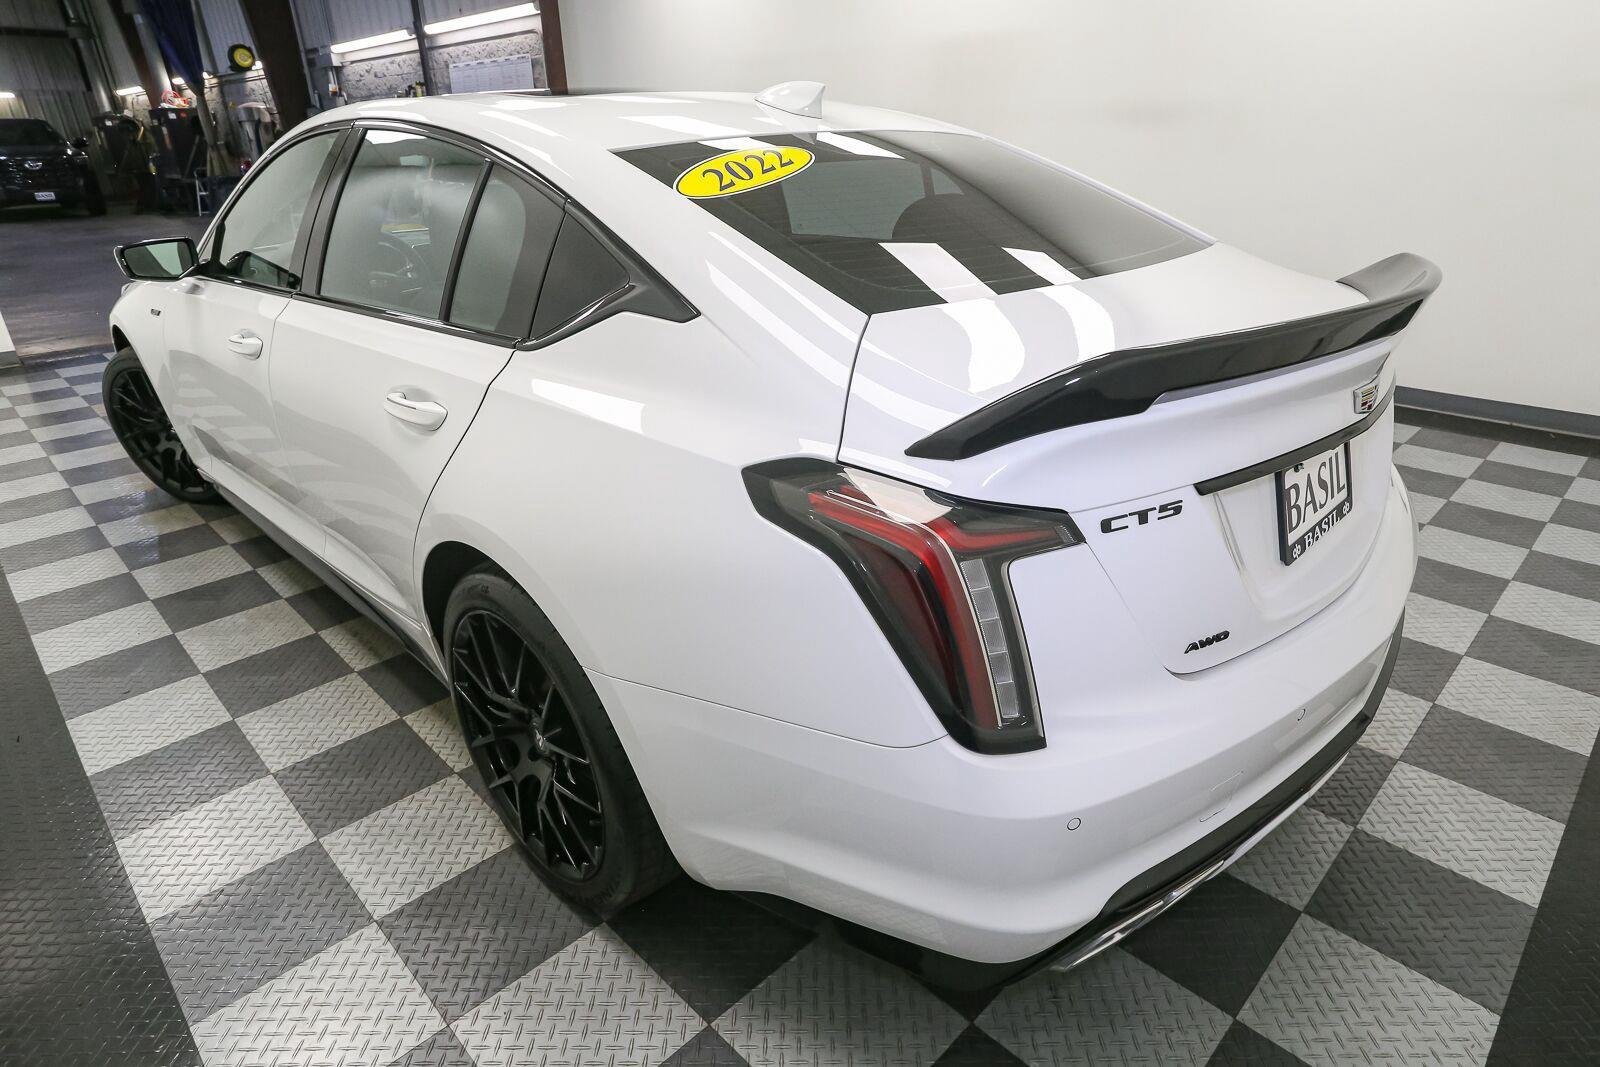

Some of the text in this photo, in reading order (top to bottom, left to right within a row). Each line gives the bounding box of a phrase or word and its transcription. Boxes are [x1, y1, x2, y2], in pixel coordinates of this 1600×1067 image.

[702, 150, 794, 191] 2022
[1284, 451, 1346, 534] BASIL
[1100, 499, 1184, 534] CT5
[1303, 510, 1341, 551] BASIL
[1184, 630, 1230, 654] AWD
